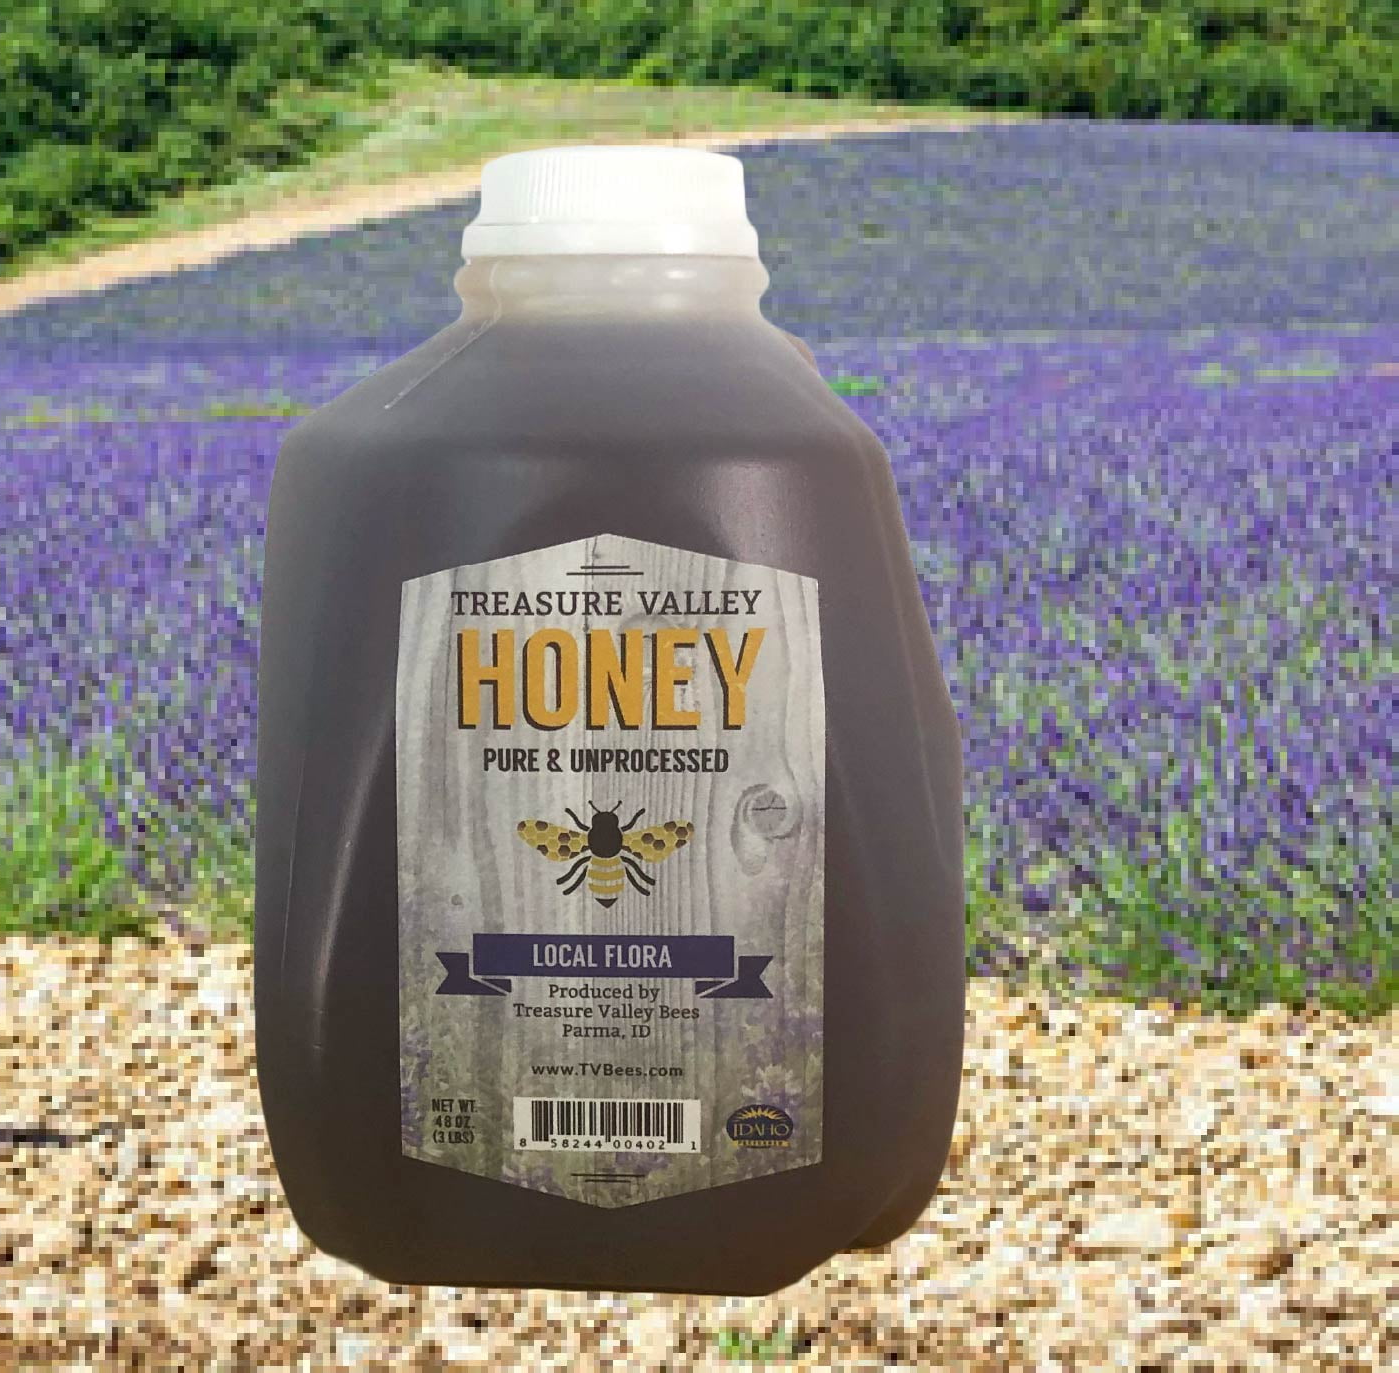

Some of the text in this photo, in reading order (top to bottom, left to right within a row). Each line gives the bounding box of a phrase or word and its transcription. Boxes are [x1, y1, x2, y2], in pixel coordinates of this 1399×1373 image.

[451, 590, 762, 616] TREASURE VALLEY
[457, 627, 768, 731] HONEY
[483, 748, 729, 773] PURE & UNPROCESSED
[533, 943, 672, 969] LOCAL FLORA
[548, 984, 661, 1002] Produced by
[513, 1003, 701, 1023] Treasure Valley Bees
[562, 1024, 652, 1040] Parma, ID
[531, 1062, 684, 1078] www.TVBees.com
[431, 1098, 478, 1113] NET WT.
[435, 1115, 476, 1129] 48 OZ.
[433, 1129, 475, 1144] (3 LBS)
